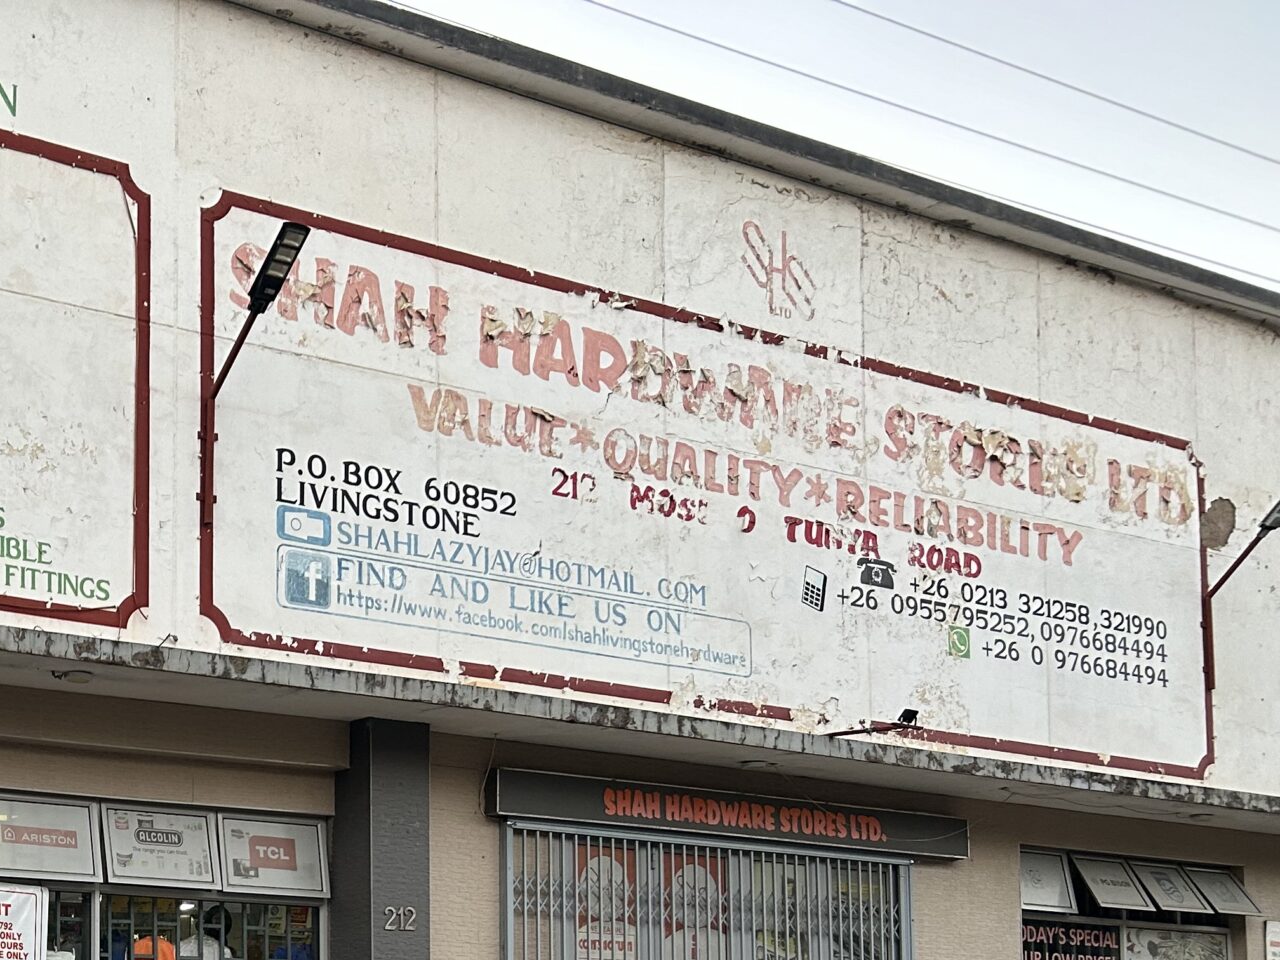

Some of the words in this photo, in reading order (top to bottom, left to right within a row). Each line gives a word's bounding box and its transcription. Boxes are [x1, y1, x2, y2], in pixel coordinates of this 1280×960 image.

[342, 461, 403, 495] BOX
[424, 477, 518, 517] 60852
[275, 477, 481, 538] LIVINGSTONE
[907, 540, 982, 579] ROAD
[5, 563, 111, 602] FITTINGS
[336, 557, 408, 591] FIND
[429, 573, 489, 605] AND
[509, 585, 577, 620] LIKE
[595, 600, 628, 627] US
[647, 609, 682, 636] ON
[836, 585, 879, 610] +26
[910, 575, 950, 599] +26
[960, 582, 1008, 609] 0213
[982, 638, 1020, 661] +26
[1031, 645, 1044, 667] 0
[1055, 652, 1170, 689] 976684494
[602, 788, 662, 819] SHAH
[665, 794, 776, 832] HARDWARE
[779, 806, 848, 839] STORES
[849, 814, 888, 842] LTD.
[21, 831, 76, 845] ARISTON
[138, 830, 179, 845] ALCOLIN
[255, 845, 290, 860] TCL
[384, 905, 417, 932] 212
[0, 931, 22, 941] ONLY
[1069, 927, 1119, 949] SPECIAL
[6, 951, 29, 960] ONLY
